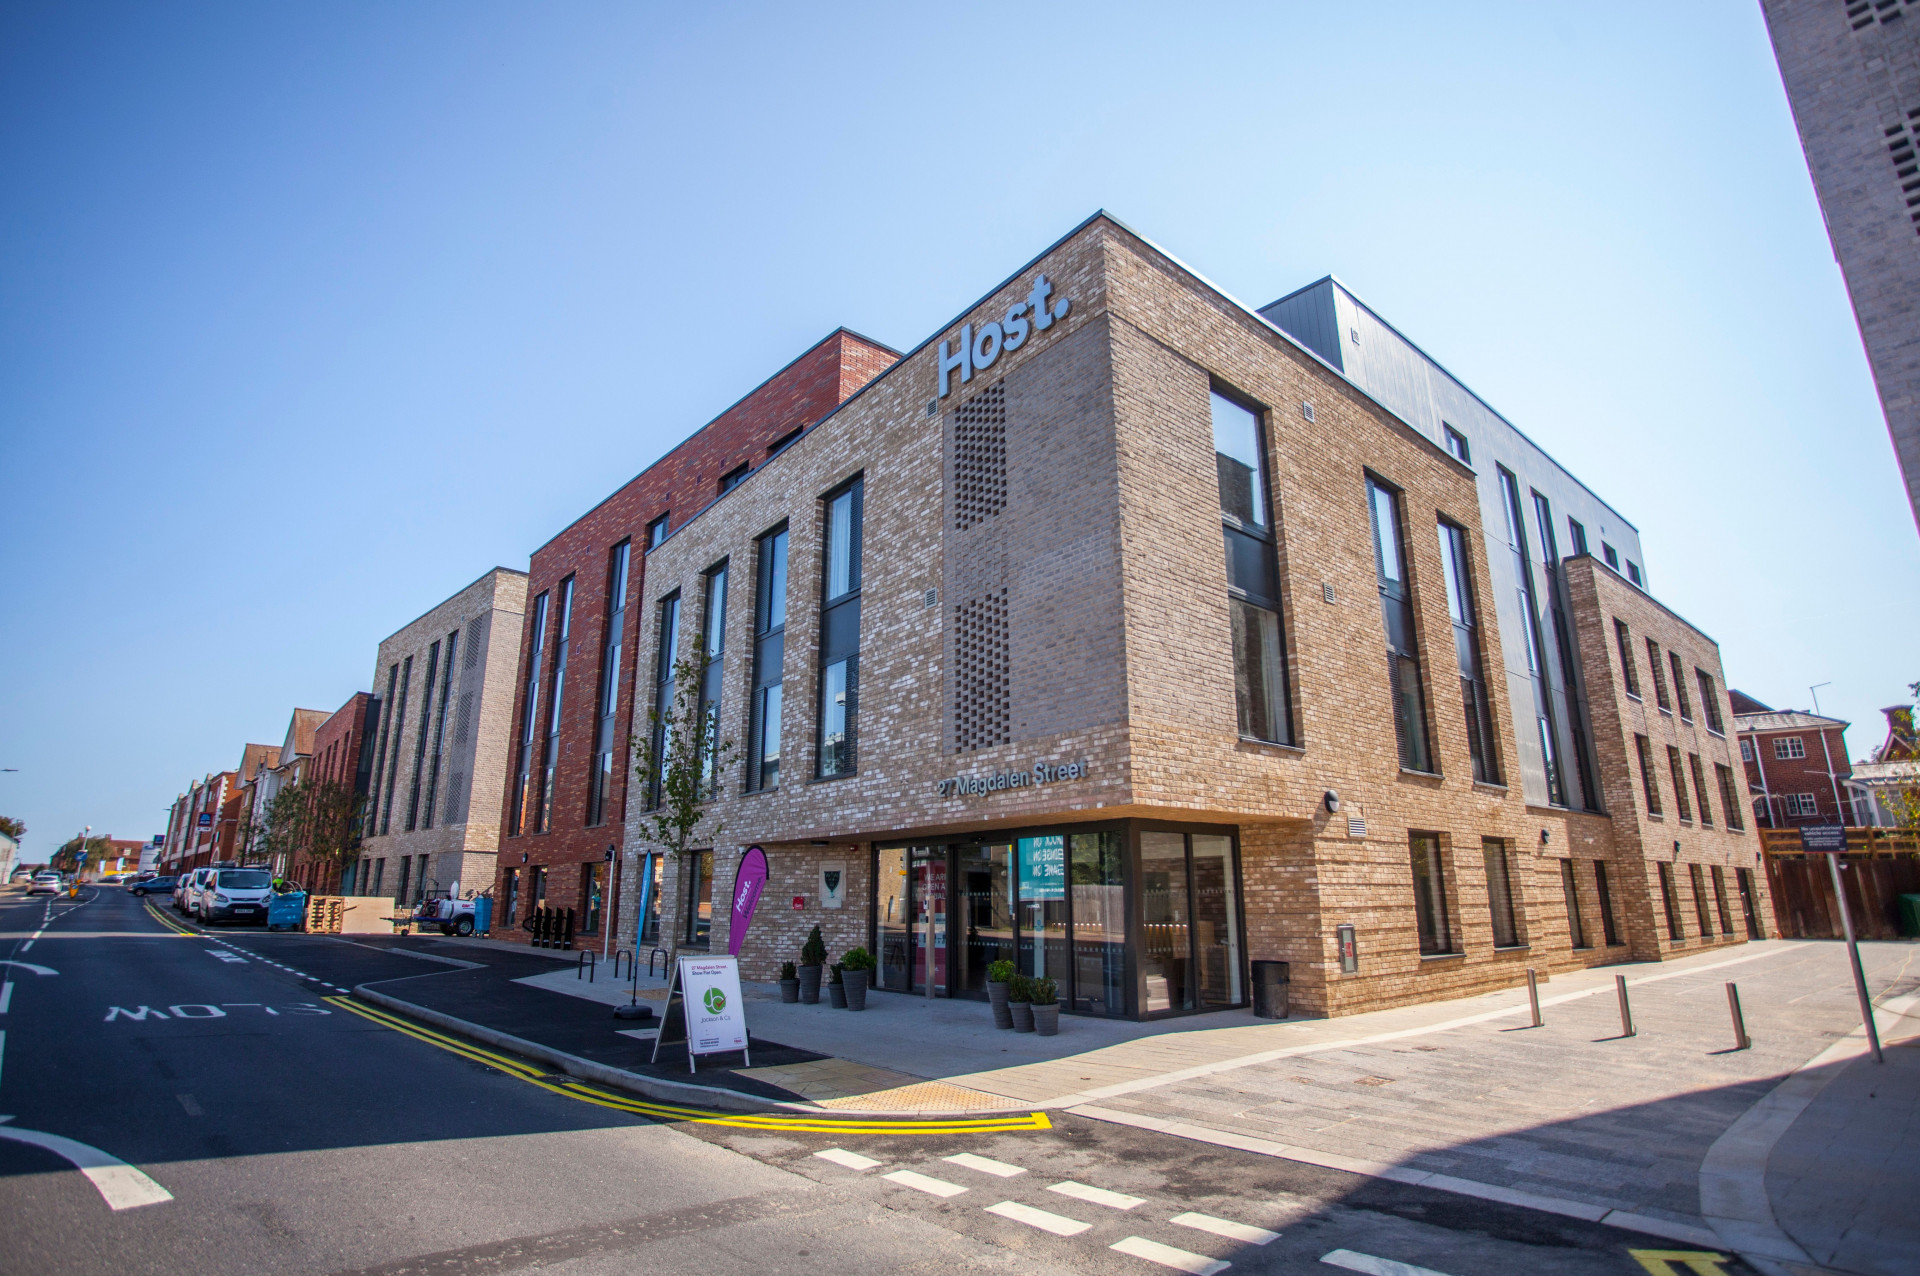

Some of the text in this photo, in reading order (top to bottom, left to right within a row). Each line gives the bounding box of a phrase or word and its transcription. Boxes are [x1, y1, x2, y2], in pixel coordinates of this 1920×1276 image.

[938, 274, 1071, 399] Host.
[938, 757, 1088, 798] 27 Magdalen Street
[736, 880, 751, 913] Host.
